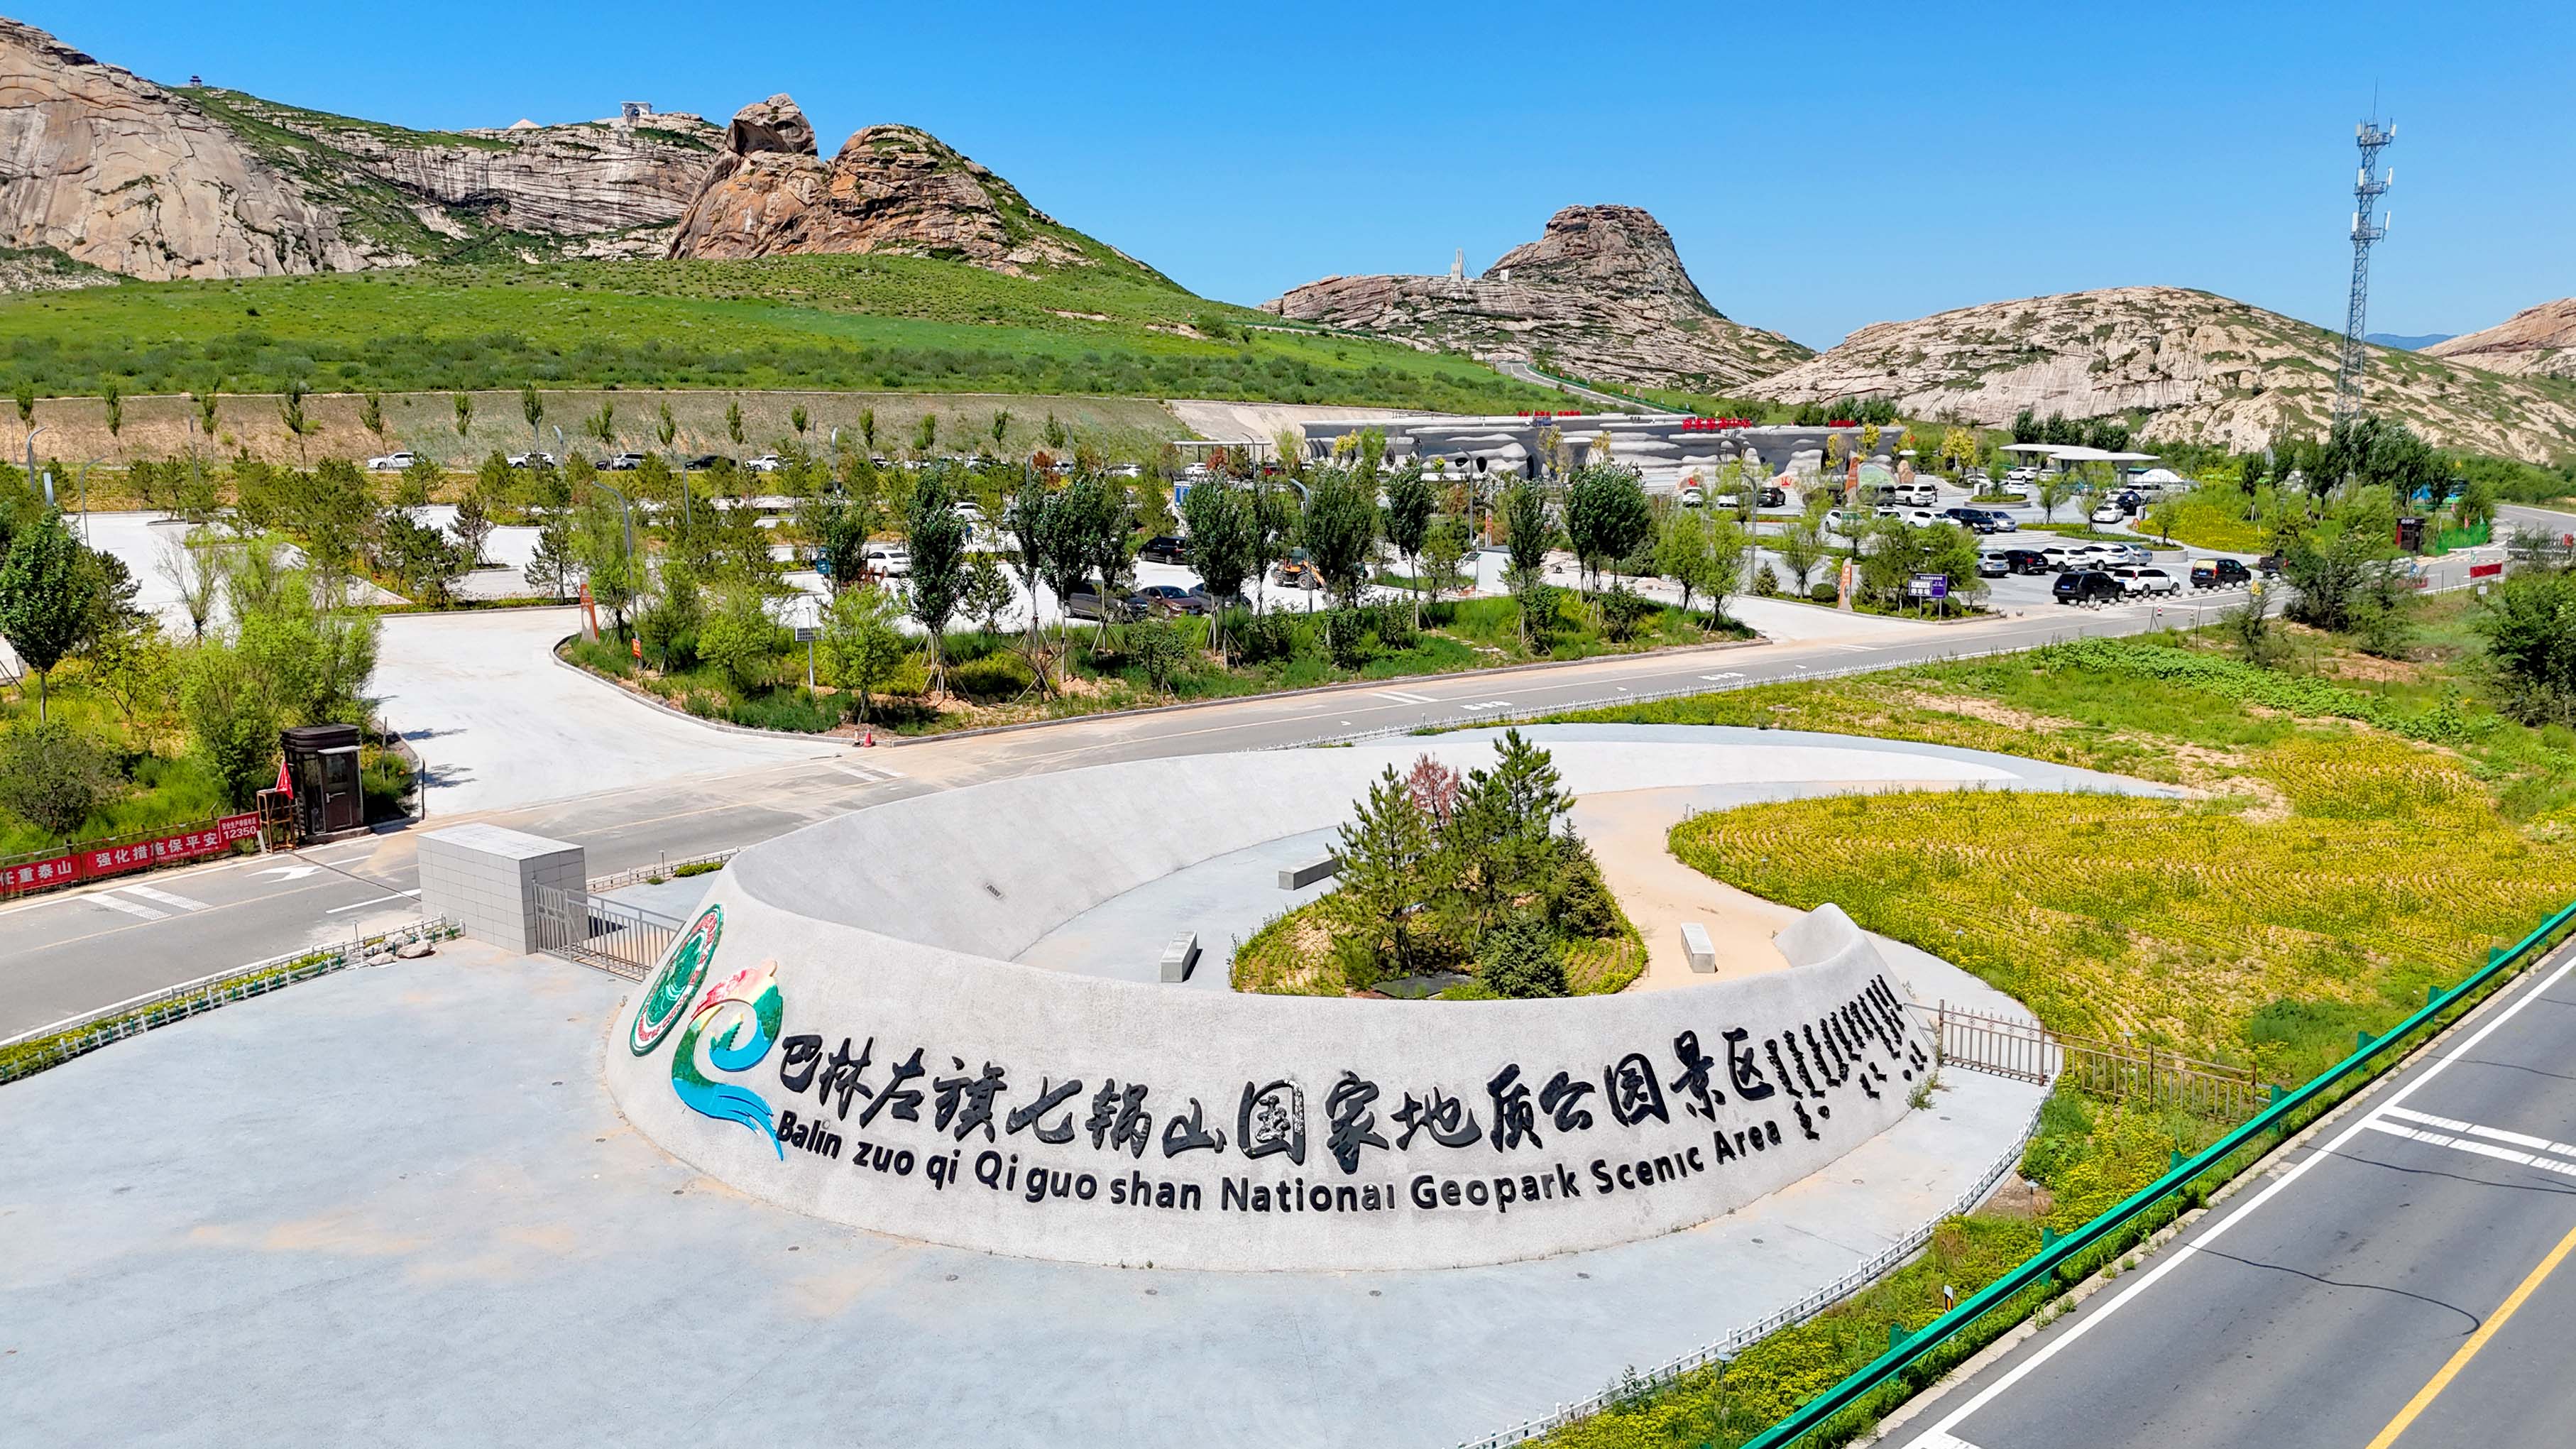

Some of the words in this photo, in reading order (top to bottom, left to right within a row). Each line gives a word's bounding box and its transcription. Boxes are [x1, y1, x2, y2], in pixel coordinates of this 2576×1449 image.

[96, 832, 218, 868] 强化措施保平安
[224, 825, 257, 839] 12350
[777, 1110, 842, 1159] Balin
[853, 1142, 914, 1176] zuo
[926, 1149, 960, 1191] qi
[975, 1151, 1018, 1191] Qi
[1026, 1168, 1097, 1203] guo
[1111, 1171, 1200, 1210] shan
[1411, 1164, 1581, 1213] Geopark
[1591, 1147, 1704, 1194] Scenic
[1714, 1121, 1782, 1165] Area
